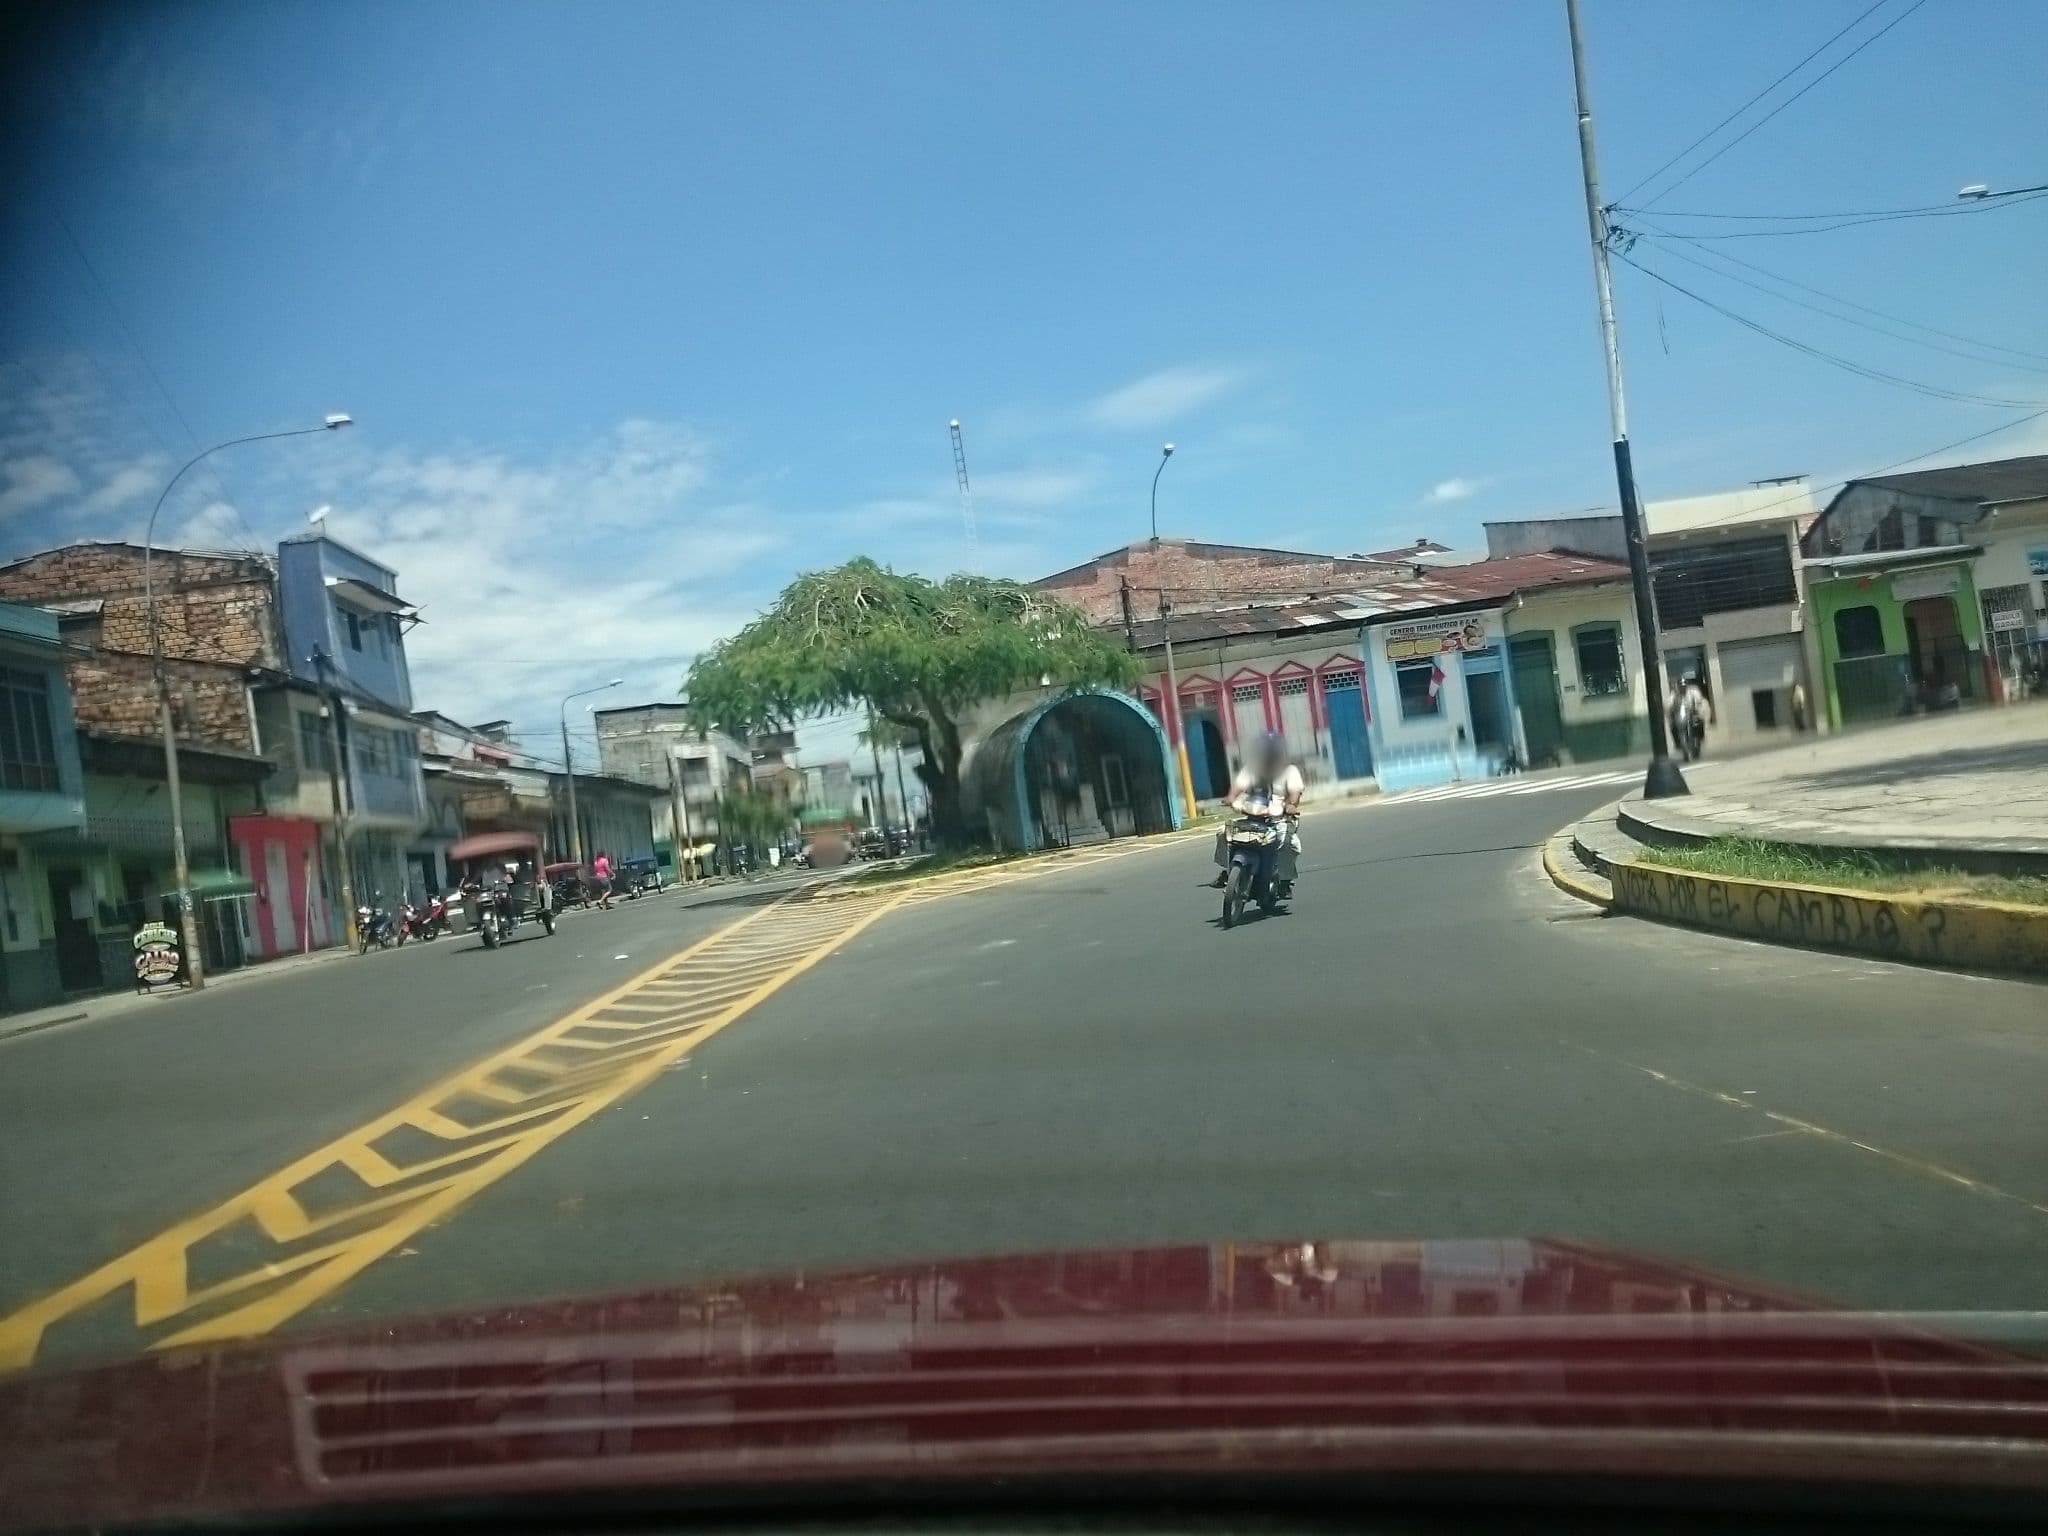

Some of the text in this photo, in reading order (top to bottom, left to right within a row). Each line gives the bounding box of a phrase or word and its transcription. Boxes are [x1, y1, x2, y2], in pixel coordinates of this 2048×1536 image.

[1390, 626, 1415, 635] CENTRO
[1666, 874, 1697, 914] POR
[135, 951, 180, 970] CALDO
